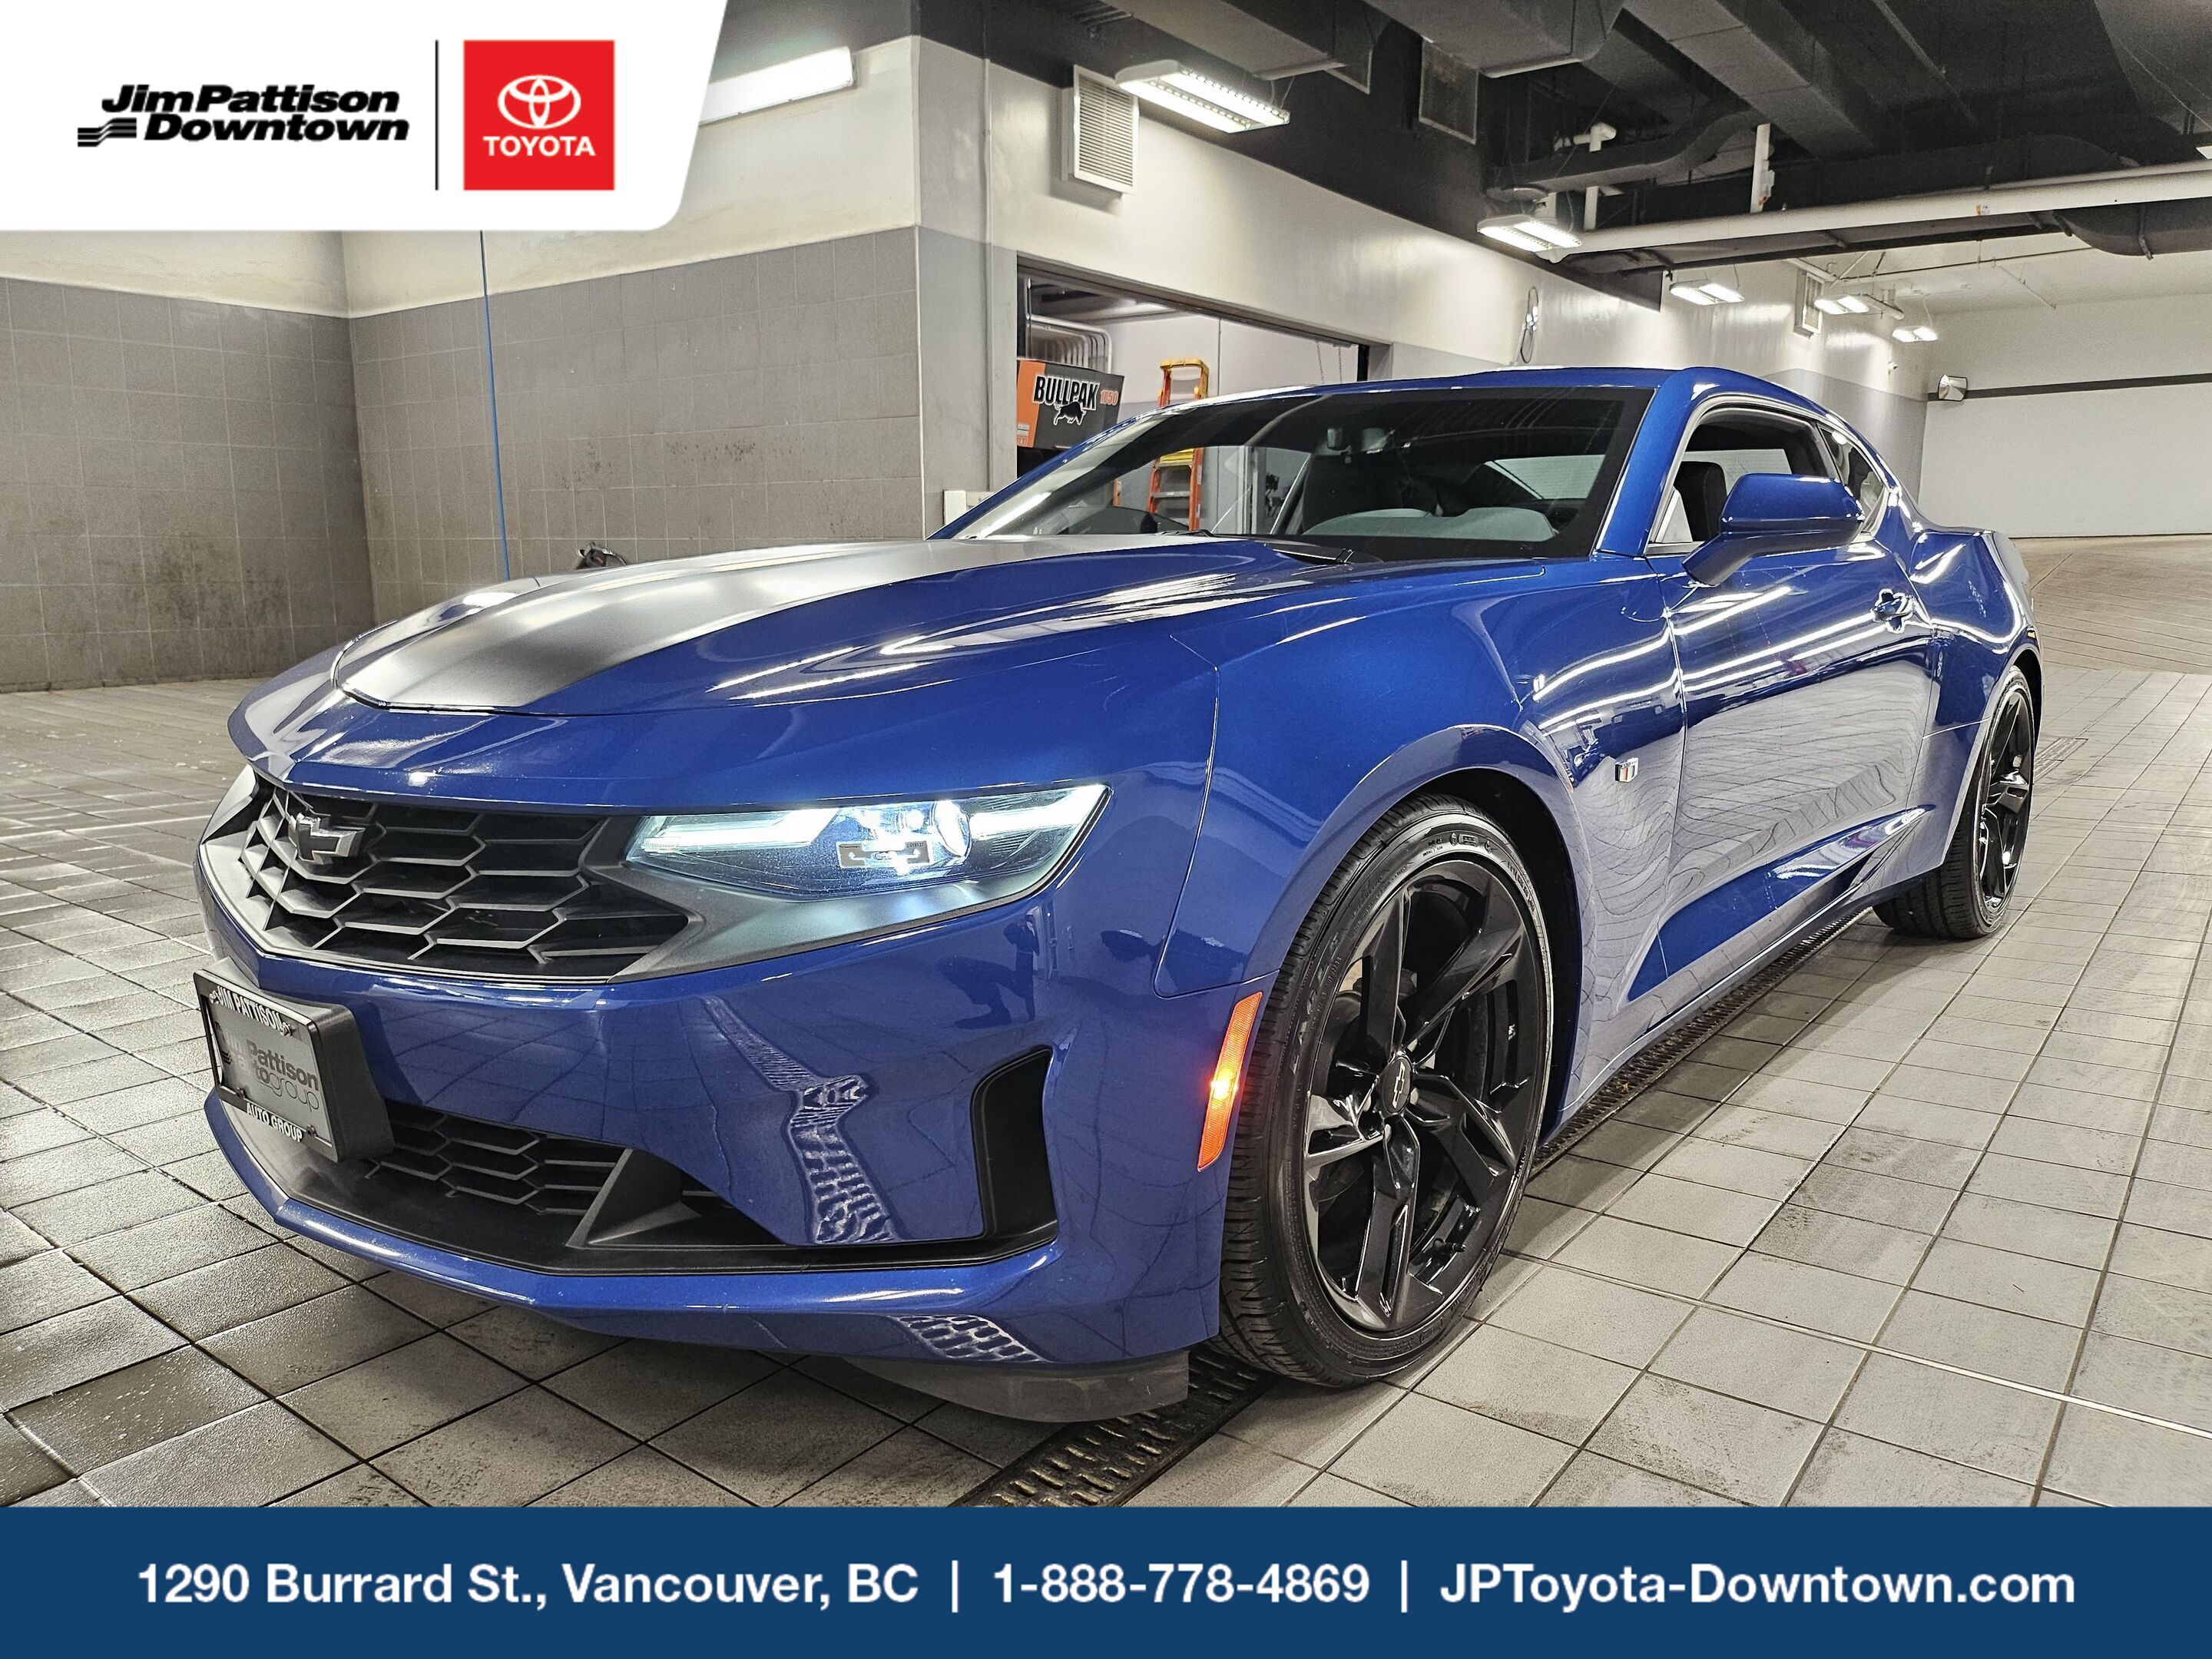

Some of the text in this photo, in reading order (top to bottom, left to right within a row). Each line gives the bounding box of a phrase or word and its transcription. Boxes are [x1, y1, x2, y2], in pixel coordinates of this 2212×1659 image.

[1032, 374, 1119, 411] BULLPAK 1050
[215, 985, 283, 1032] JIM PATTISON
[246, 1038, 320, 1092] Pattison
[247, 1102, 303, 1143] AUTO GROUP
